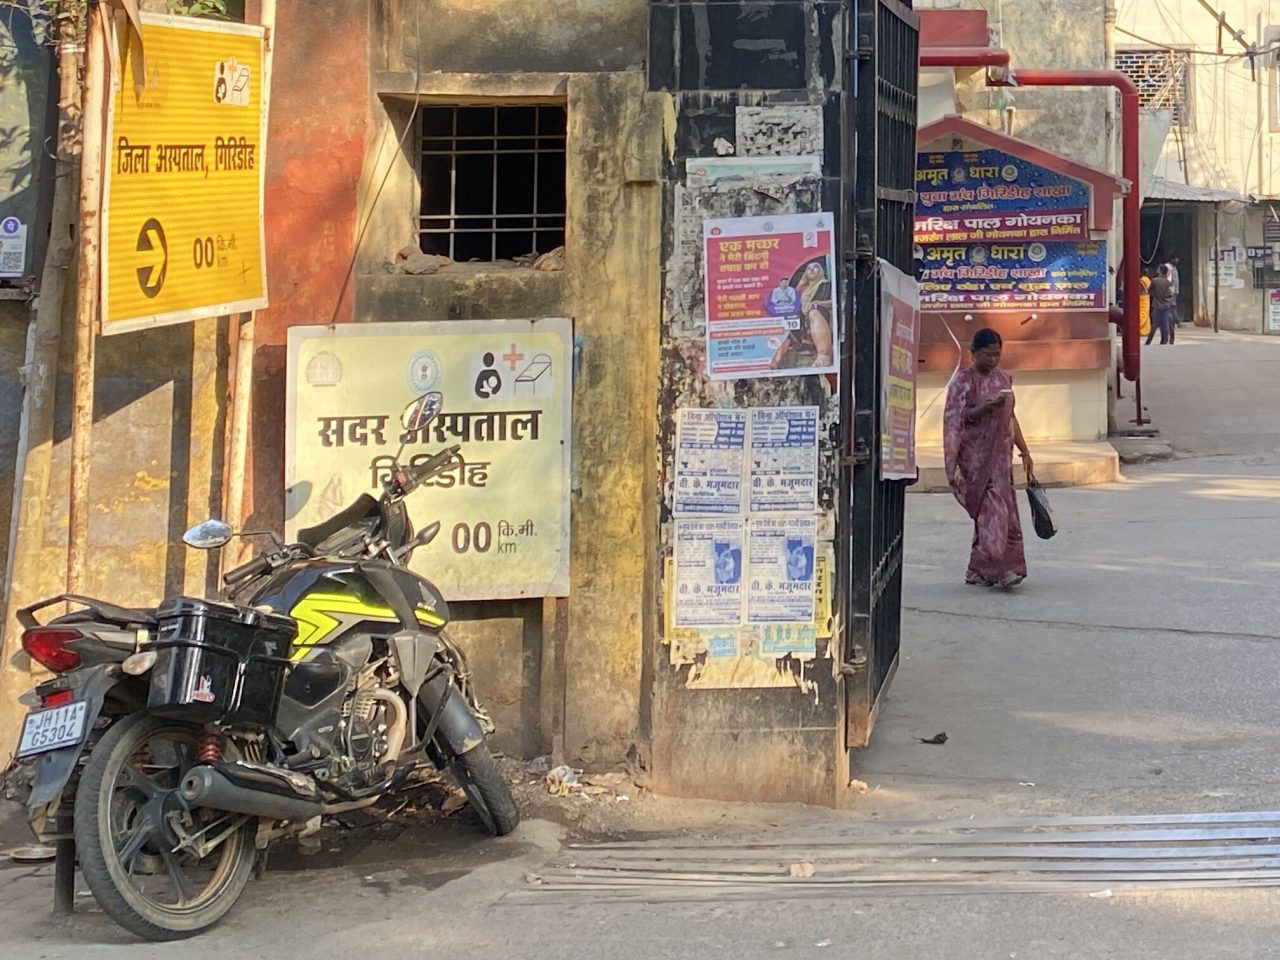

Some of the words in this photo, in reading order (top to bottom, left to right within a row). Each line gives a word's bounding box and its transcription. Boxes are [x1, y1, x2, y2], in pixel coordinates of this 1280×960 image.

[117, 136, 151, 174] जिला
[156, 143, 209, 179] अस्पताल,
[214, 136, 256, 172] गिरिडीह
[969, 166, 999, 179] धारा
[976, 186, 1031, 201] गिरिडीह
[964, 217, 1002, 229] पाल
[1005, 213, 1082, 227] गोयनका
[193, 236, 215, 269] 00
[718, 241, 743, 252] एक
[926, 246, 967, 266] अमृत
[991, 246, 1025, 260] धारा
[787, 320, 798, 328] 10
[318, 415, 389, 447] सदर
[452, 522, 492, 554] 00
[498, 520, 537, 538] कि.मी.
[498, 541, 516, 554] km
[35, 706, 77, 730] JH11A
